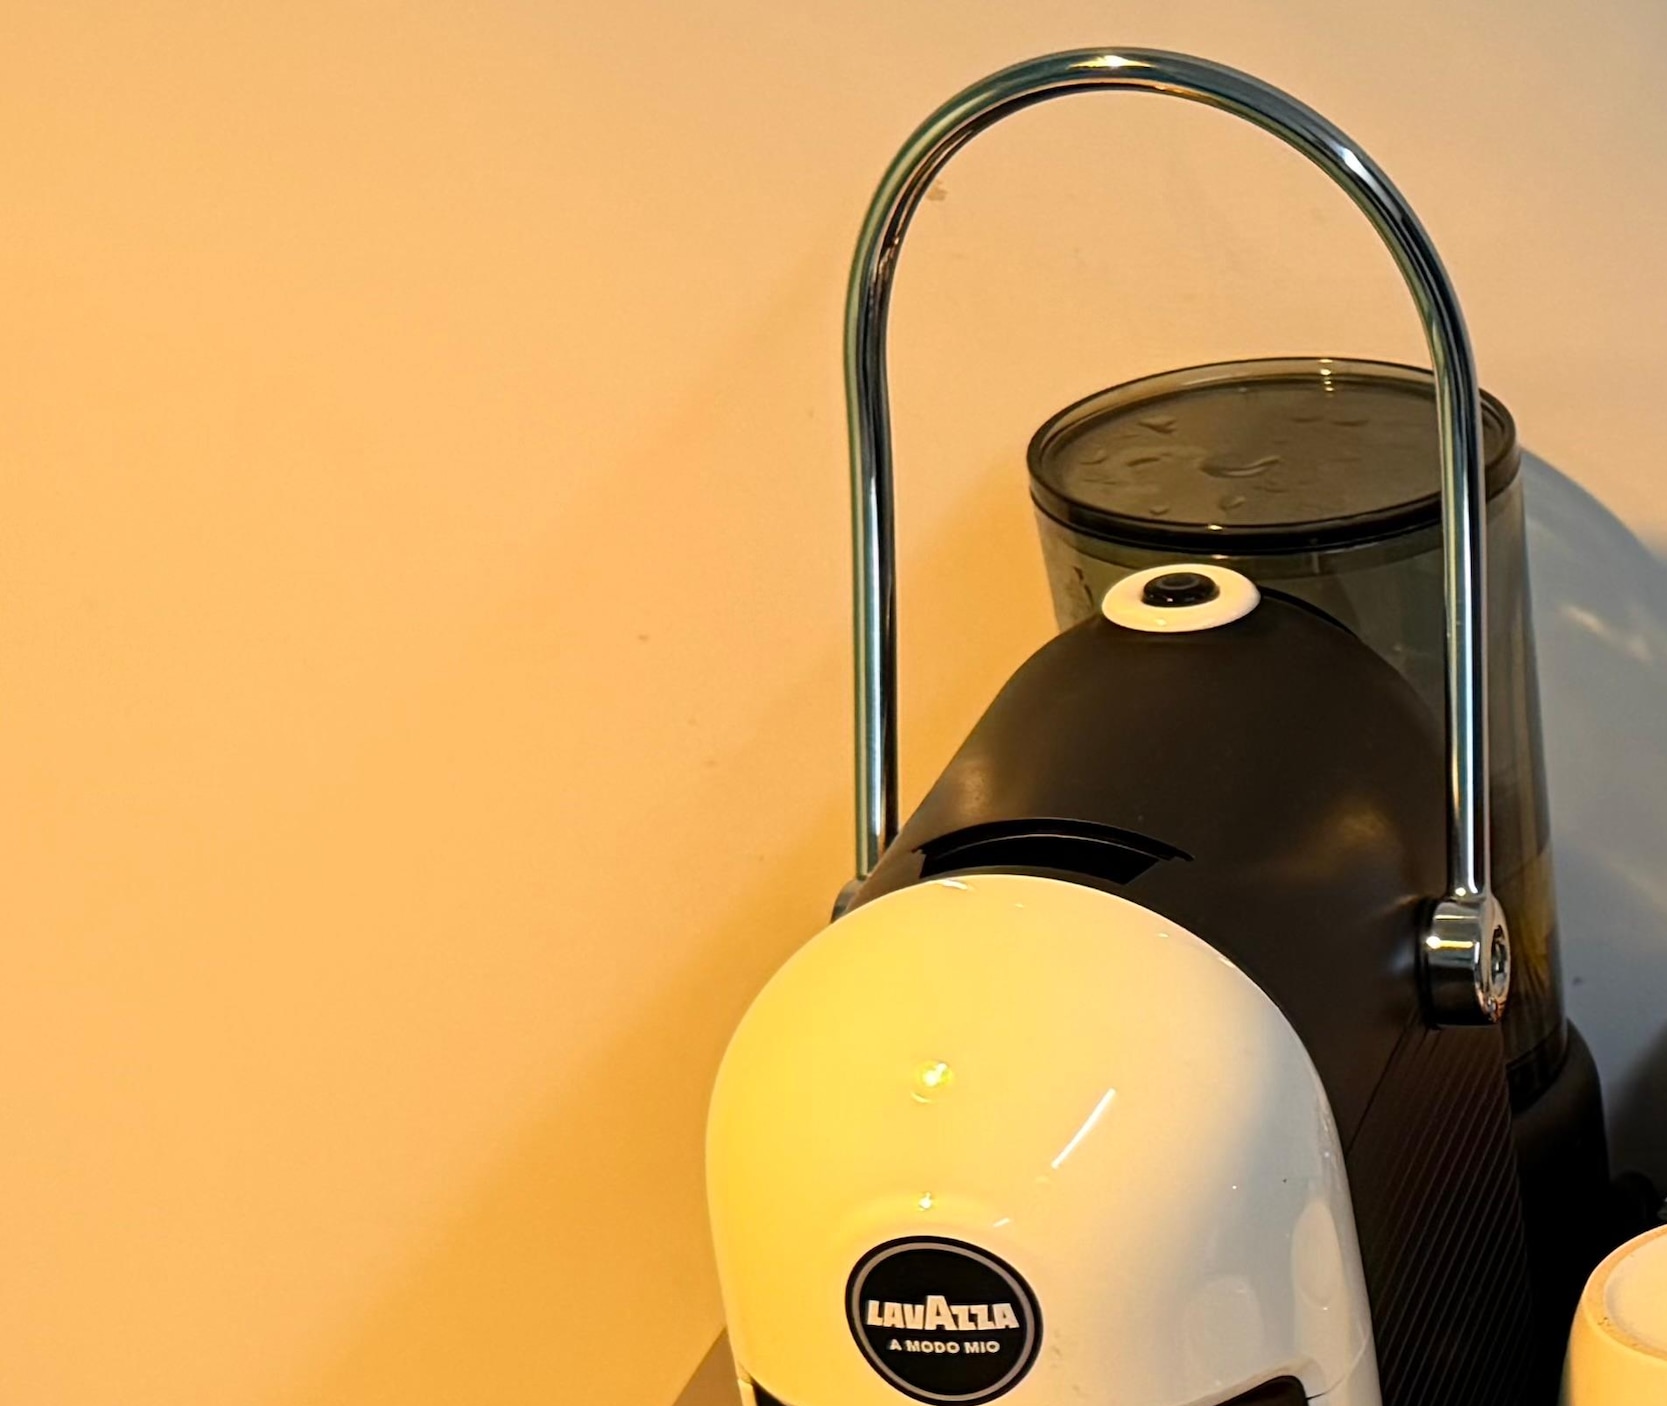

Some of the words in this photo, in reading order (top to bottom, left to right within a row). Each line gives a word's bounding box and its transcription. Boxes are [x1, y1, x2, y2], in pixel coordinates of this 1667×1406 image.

[867, 1295, 1020, 1331] LAVAZZA
[889, 1338, 902, 1351] A
[906, 1339, 960, 1354] MODO
[963, 1341, 1001, 1354] MIO
